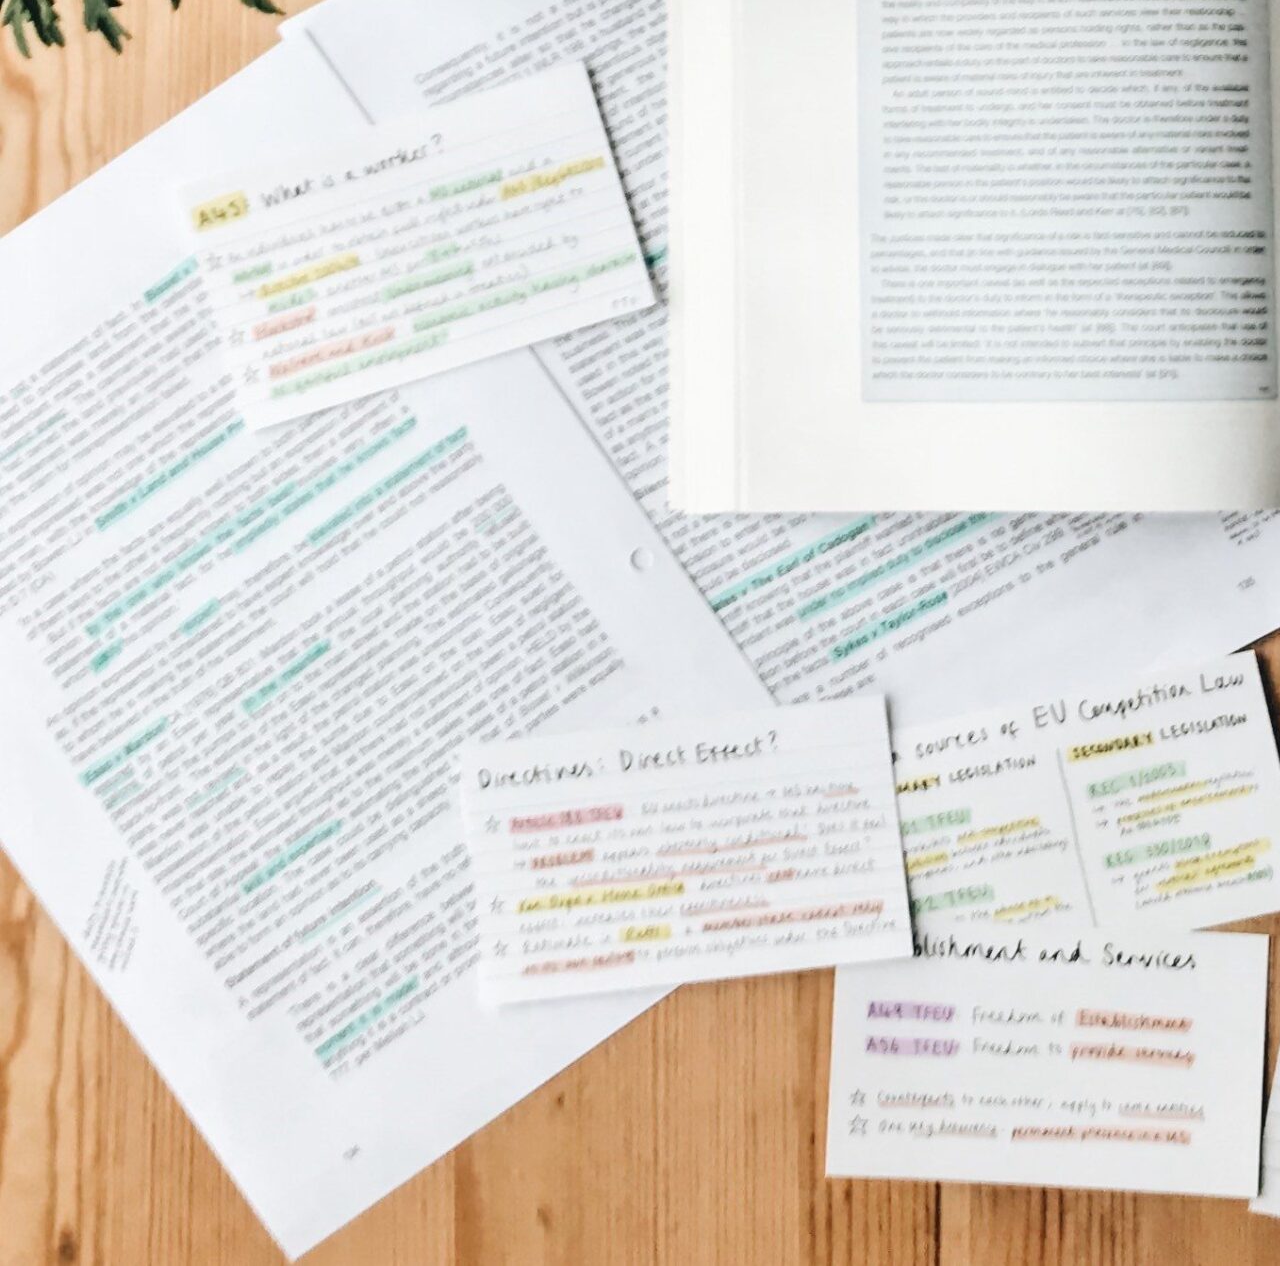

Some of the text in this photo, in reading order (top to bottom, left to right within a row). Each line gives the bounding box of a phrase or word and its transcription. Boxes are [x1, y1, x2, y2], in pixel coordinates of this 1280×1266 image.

[1033, 700, 1066, 728] EU
[1079, 685, 1191, 720] Competition
[1200, 674, 1243, 692] Law
[1160, 714, 1246, 739] LEGISLATION
[620, 746, 685, 772] Direct
[1040, 943, 1080, 962] and
[1104, 944, 1195, 969] Services
